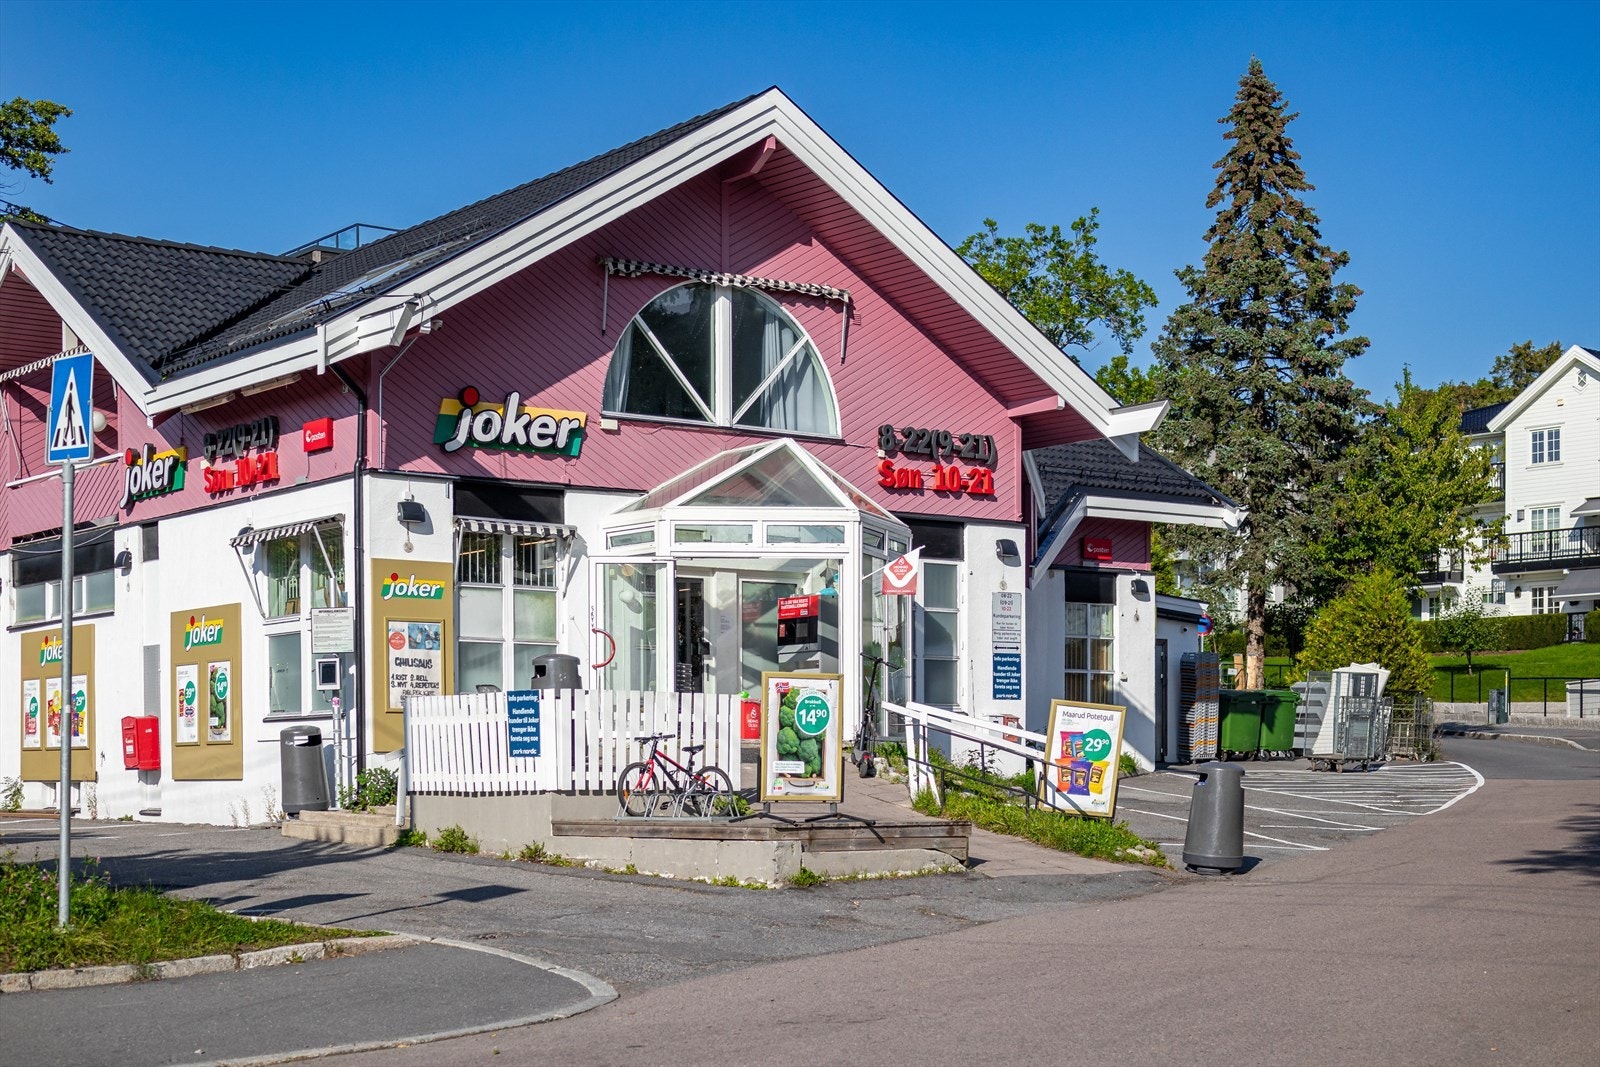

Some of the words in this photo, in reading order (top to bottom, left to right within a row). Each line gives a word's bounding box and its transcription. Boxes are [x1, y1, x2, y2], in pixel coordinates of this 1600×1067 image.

[441, 386, 581, 453] joker
[311, 431, 326, 443] posten
[119, 443, 179, 509] joker
[878, 460, 923, 489] Søn
[932, 465, 995, 494] 10-21
[383, 572, 440, 600] joker
[185, 614, 221, 652] joker
[41, 635, 63, 667] joke
[394, 656, 433, 669] CHILISAUS
[798, 709, 827, 726] 1490
[1062, 710, 1086, 719] Maarud
[1086, 713, 1114, 722] Potetgull
[512, 726, 527, 734] trenger
[1084, 738, 1110, 752] 2990
